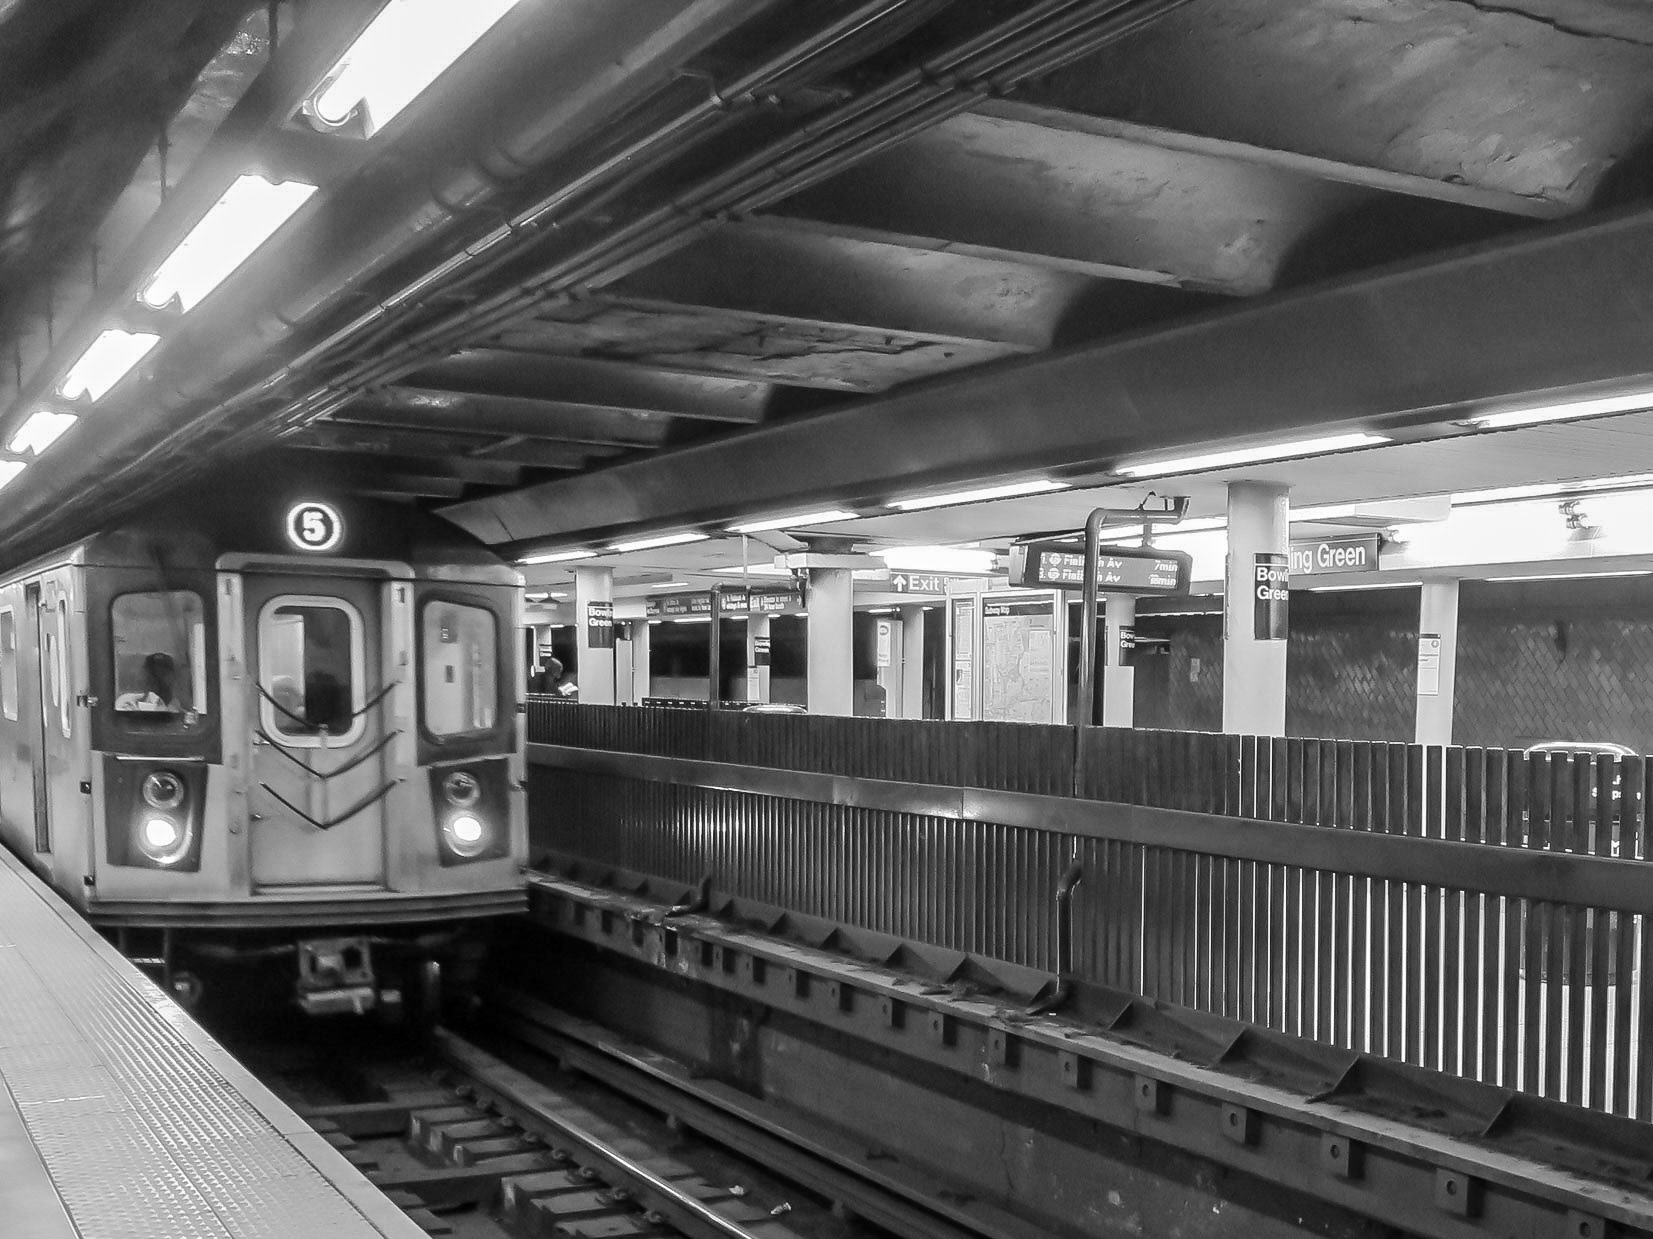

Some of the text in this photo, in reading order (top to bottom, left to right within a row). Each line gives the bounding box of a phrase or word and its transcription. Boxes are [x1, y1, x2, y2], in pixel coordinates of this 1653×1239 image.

[303, 511, 326, 541] 5
[1317, 543, 1366, 567] Green
[1106, 557, 1122, 568] Av
[1154, 560, 1178, 571] 7min
[909, 575, 940, 591] Exit
[1105, 572, 1120, 582] Av
